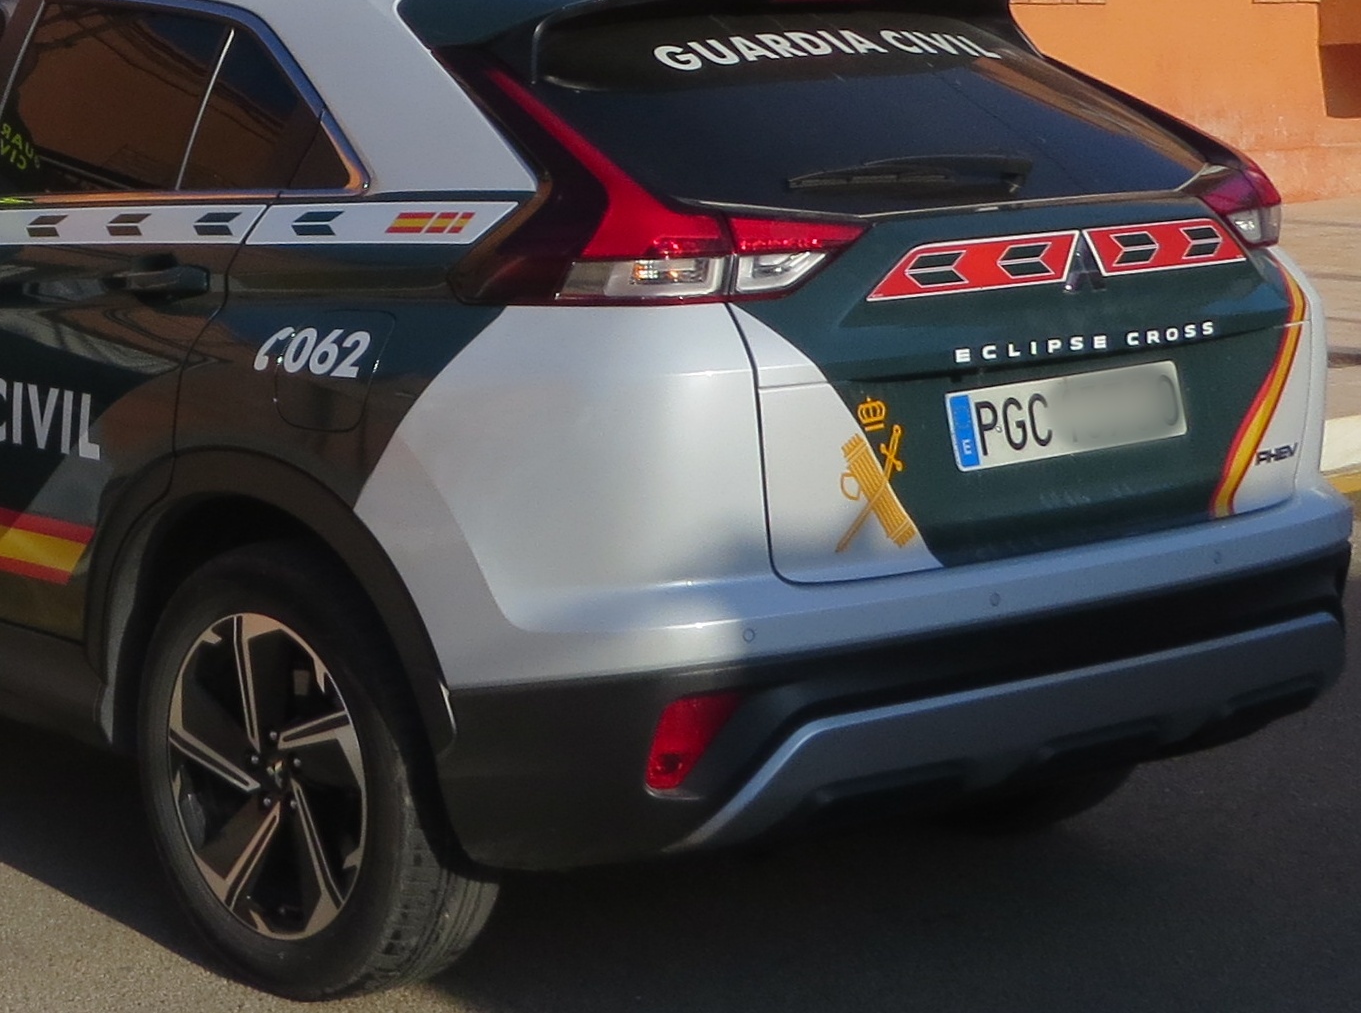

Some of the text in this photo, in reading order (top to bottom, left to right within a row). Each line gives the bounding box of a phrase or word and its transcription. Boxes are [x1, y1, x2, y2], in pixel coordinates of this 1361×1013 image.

[653, 29, 1002, 72] GUARDIA CIVIL
[283, 328, 371, 379] 062
[954, 321, 1214, 363] ECLIPSE CROSS
